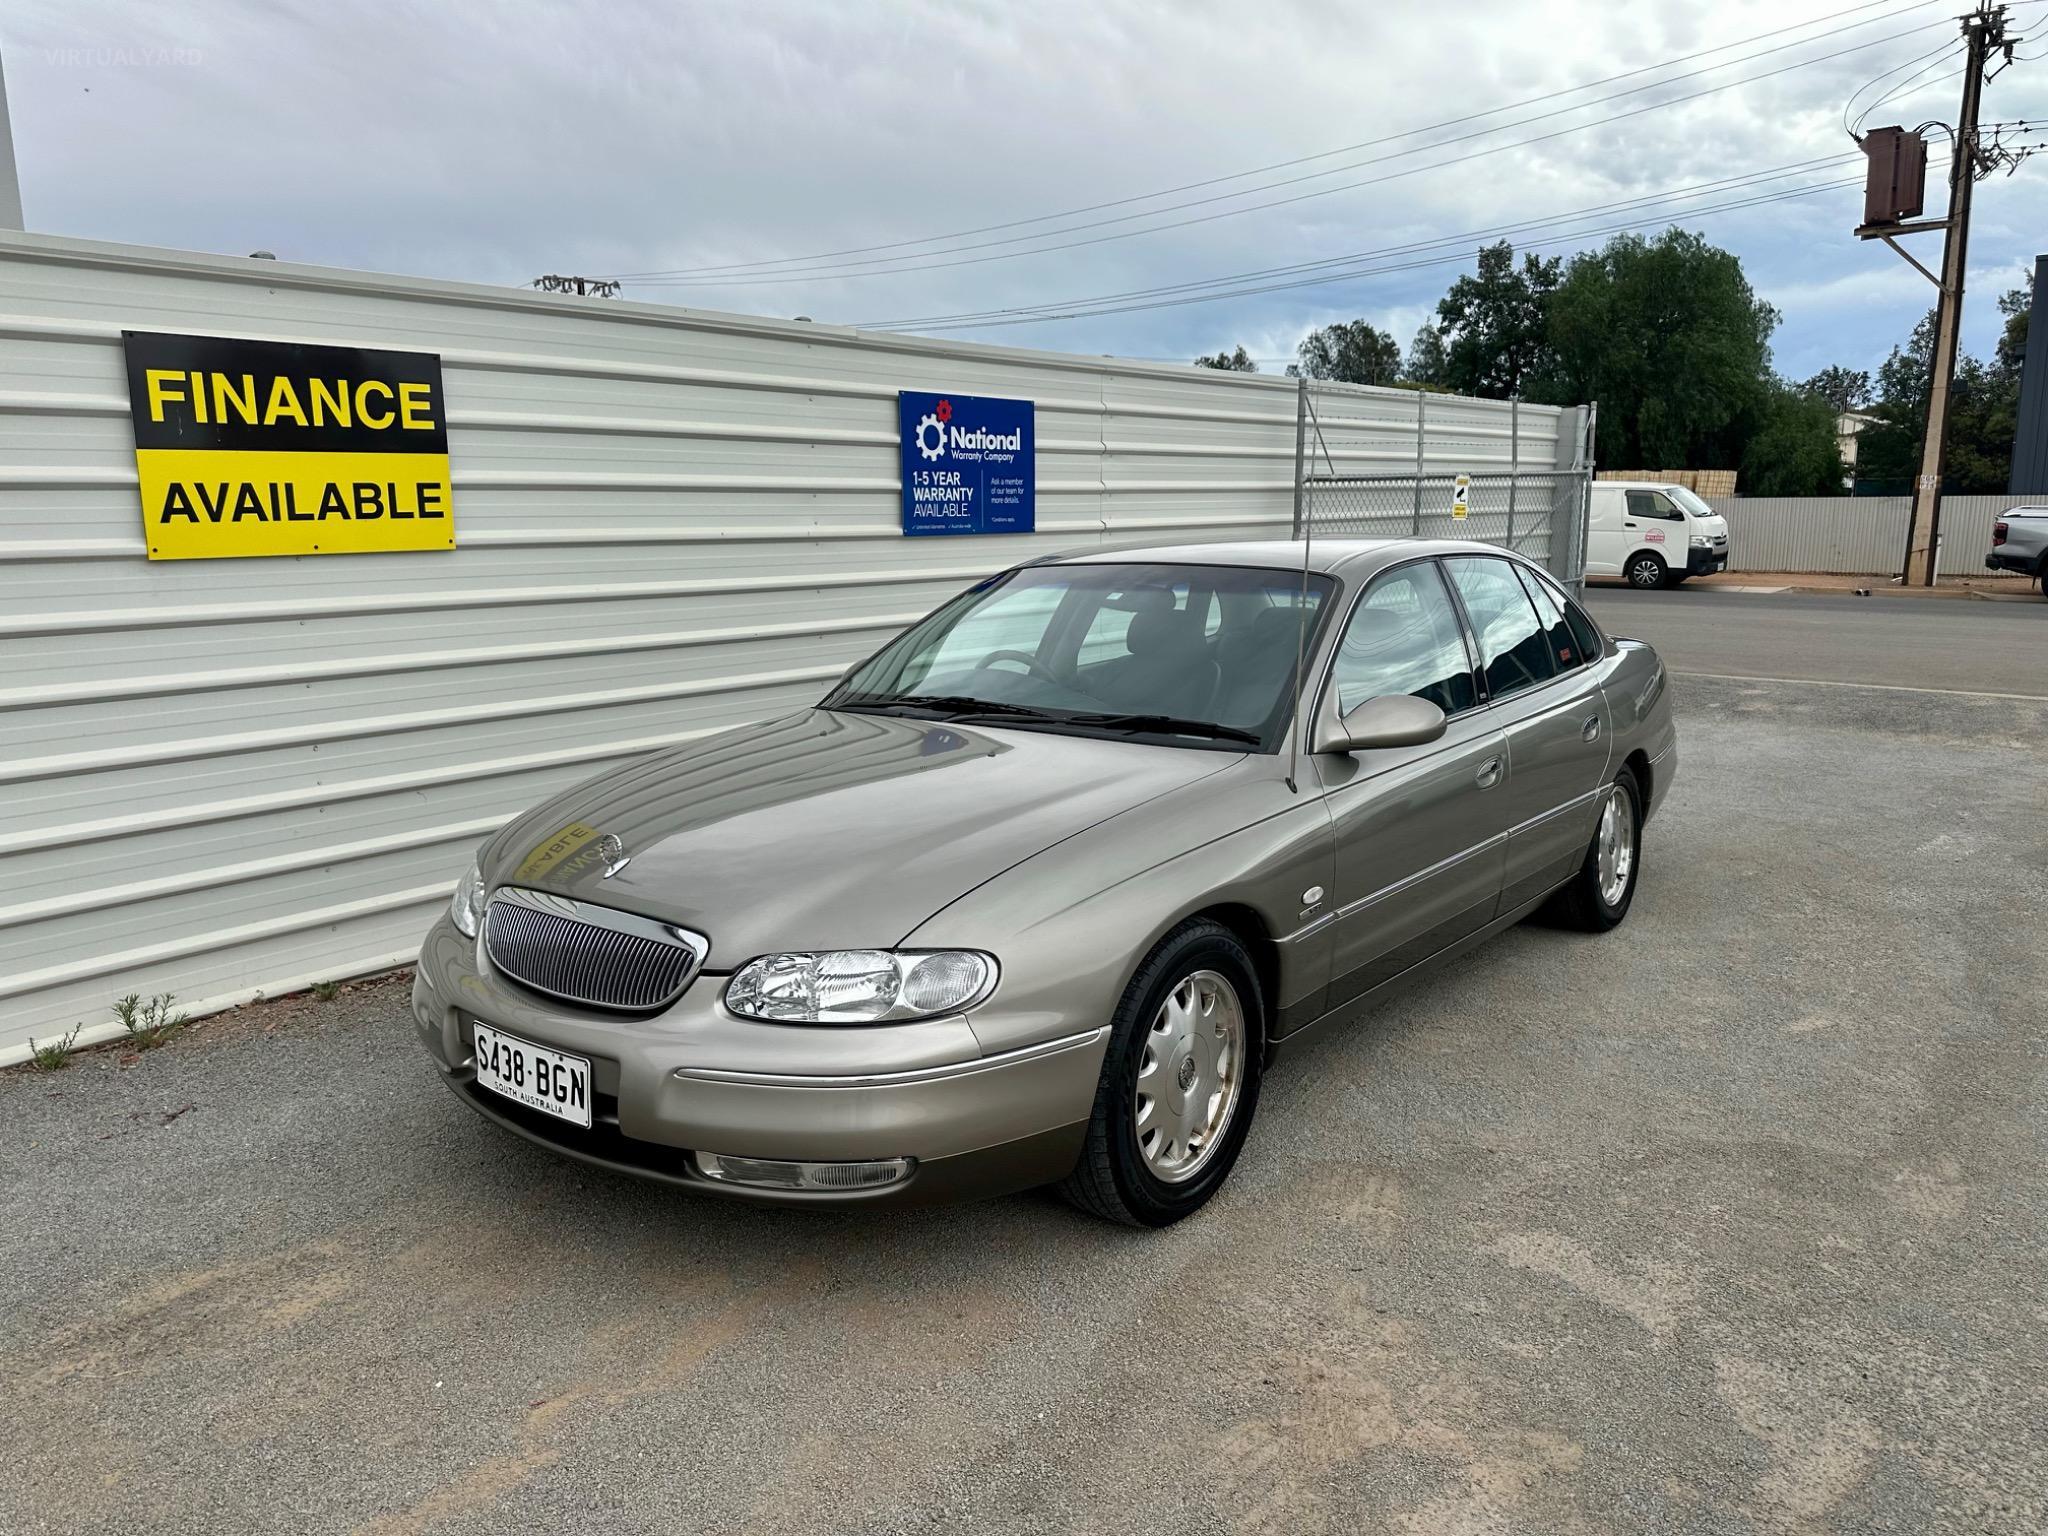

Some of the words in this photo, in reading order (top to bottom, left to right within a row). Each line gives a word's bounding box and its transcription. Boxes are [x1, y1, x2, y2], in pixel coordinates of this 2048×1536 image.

[146, 369, 436, 430] FINANCE
[951, 426, 1020, 450] National
[951, 449, 982, 463] Warranty
[984, 450, 1014, 464] Company
[913, 471, 929, 485] 1-5
[932, 471, 961, 485] YEAR
[160, 482, 445, 523] AVAILABLE
[913, 487, 973, 501] WARRANTY
[913, 503, 970, 517] AVAILABLE.
[495, 1081, 518, 1099] SOUTH
[520, 1091, 564, 1115] AUSTRALIA
